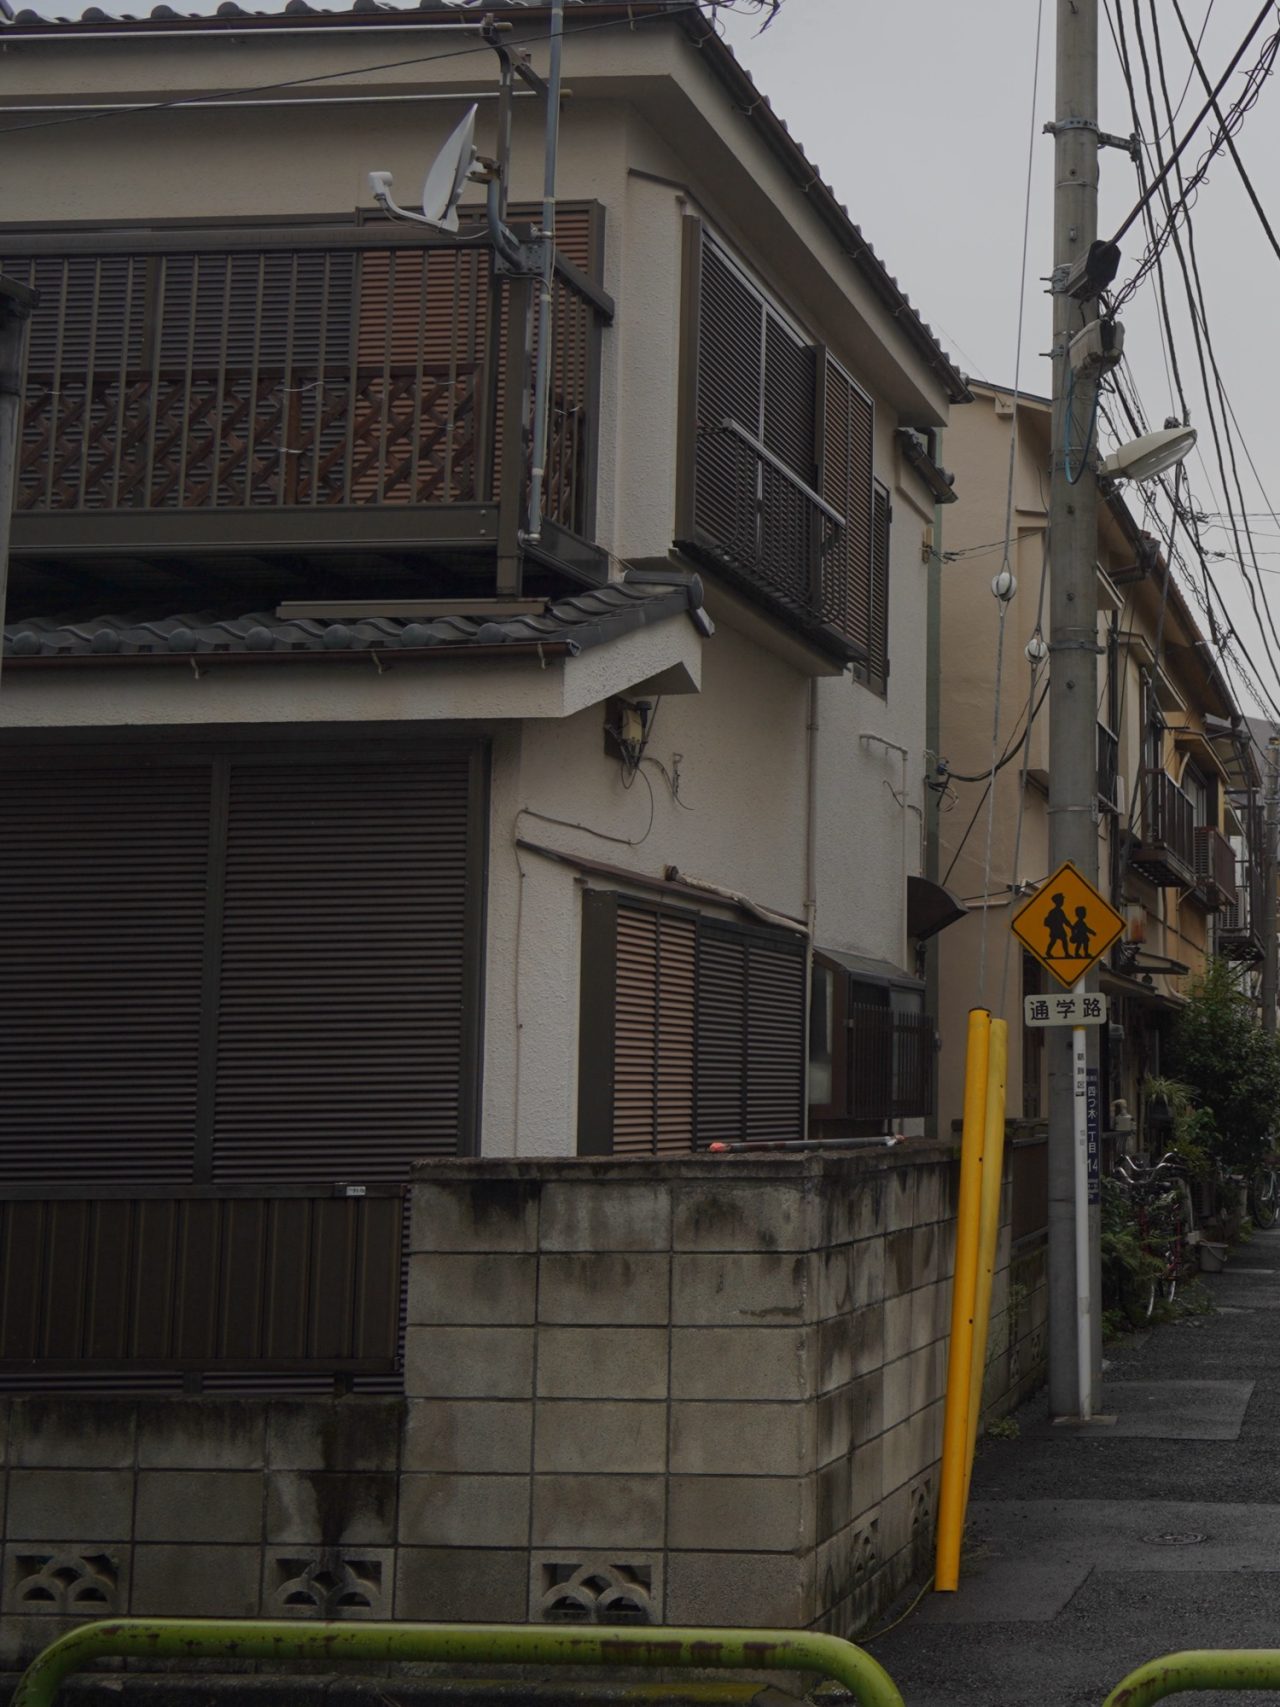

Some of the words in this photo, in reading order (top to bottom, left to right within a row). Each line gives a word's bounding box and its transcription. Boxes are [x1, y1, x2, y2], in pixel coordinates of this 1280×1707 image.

[1030, 998, 1101, 1021] 通学路
[1087, 1159, 1098, 1173] 14
